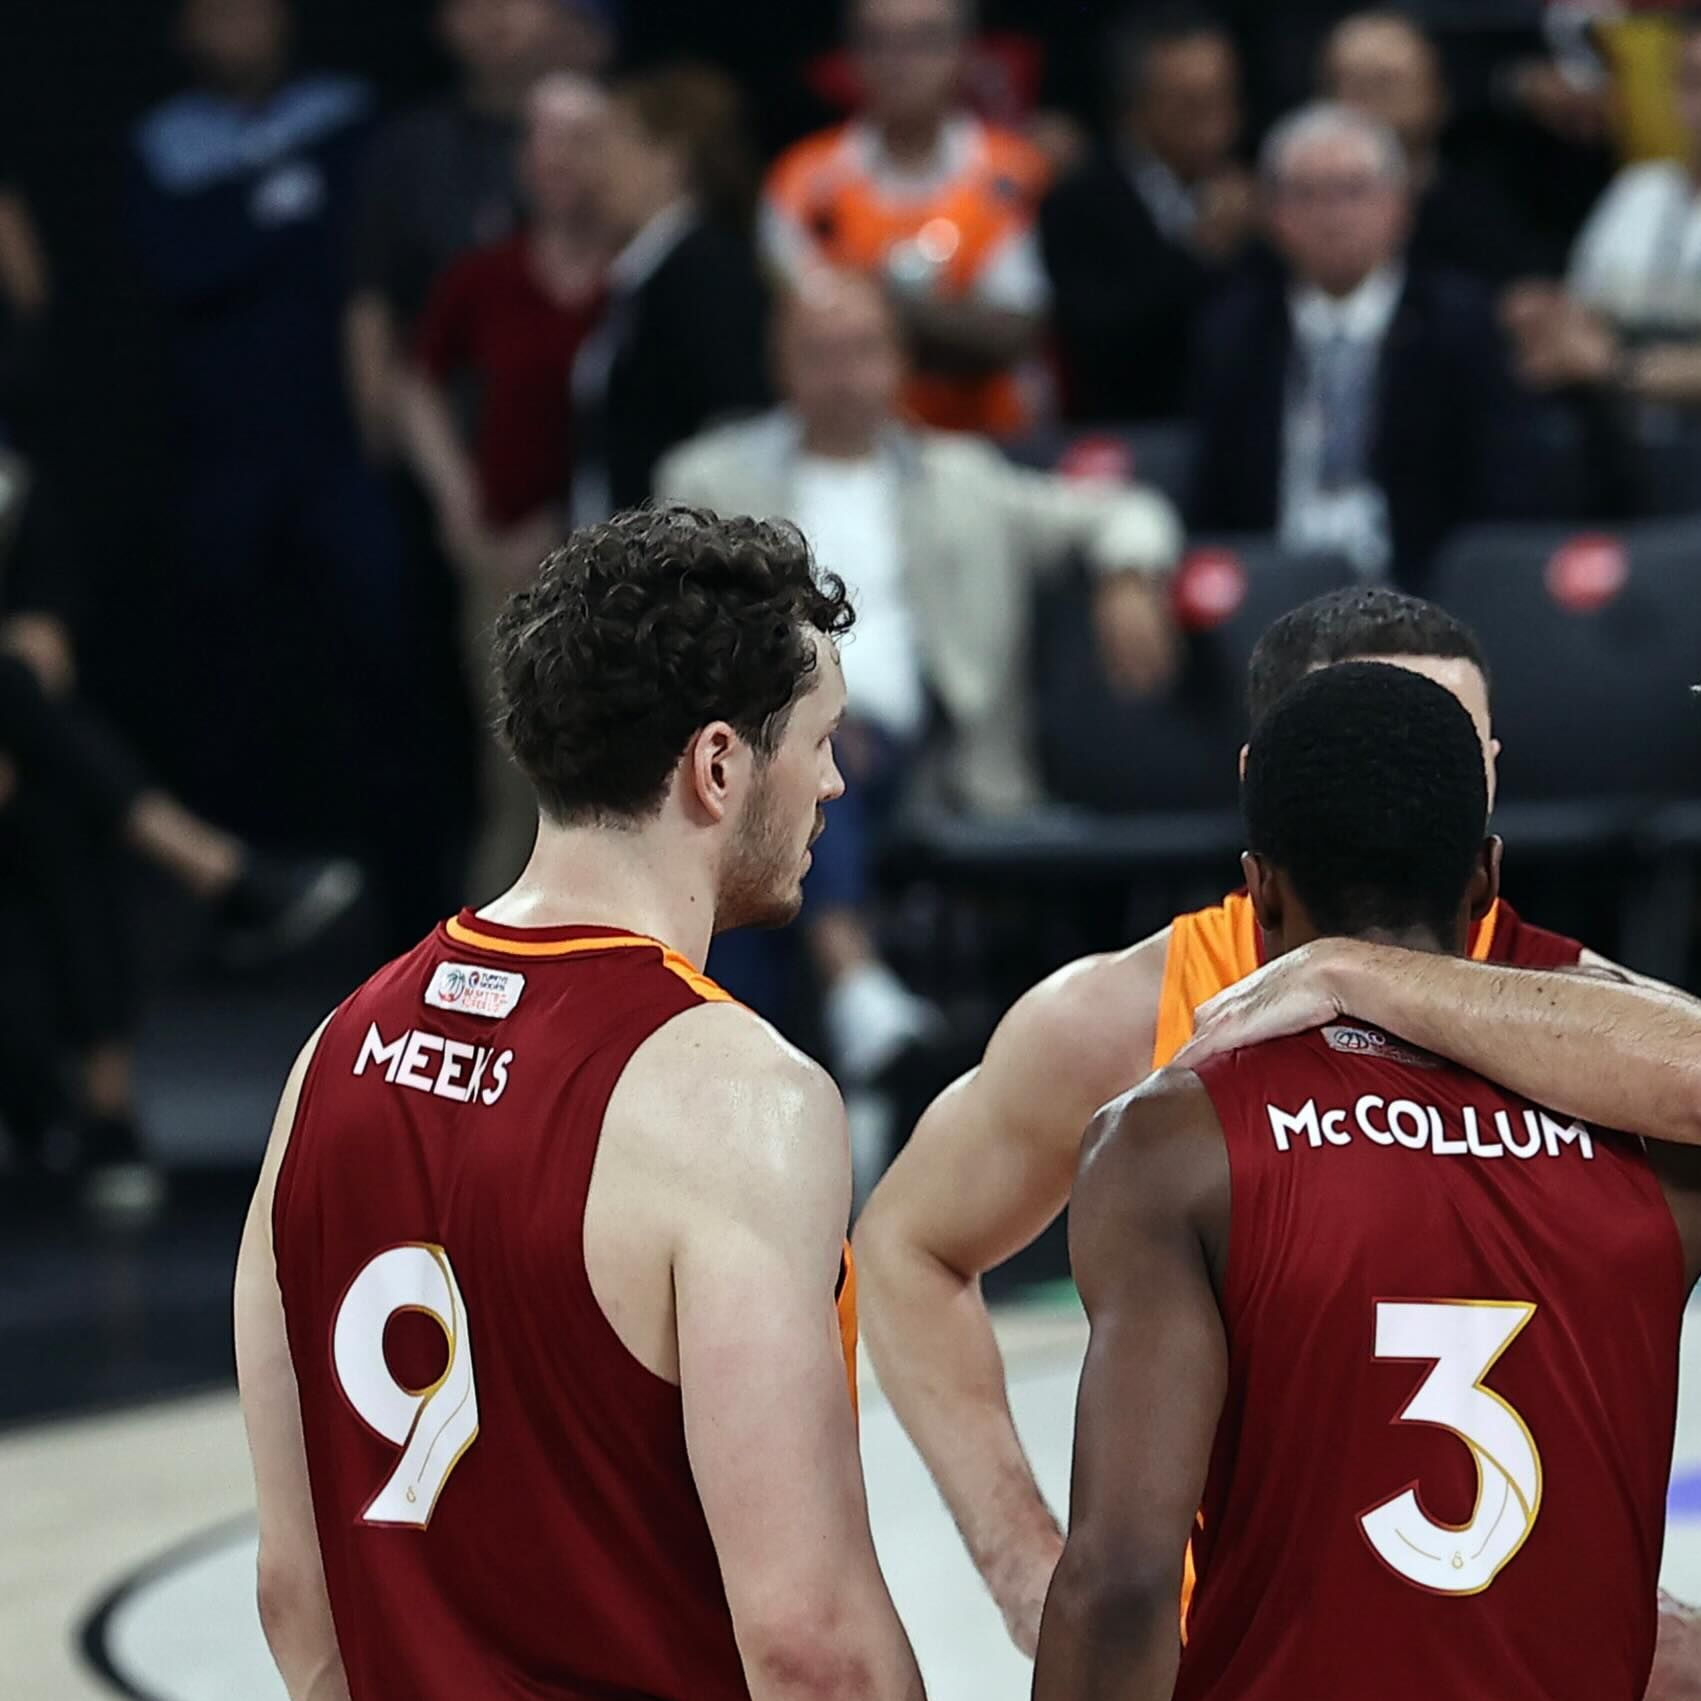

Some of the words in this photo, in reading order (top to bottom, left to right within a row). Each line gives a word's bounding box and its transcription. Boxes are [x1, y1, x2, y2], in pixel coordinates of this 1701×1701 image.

[352, 1020, 515, 1106] MEEKS
[331, 1241, 480, 1531] 9
[1359, 1297, 1543, 1596] 3
